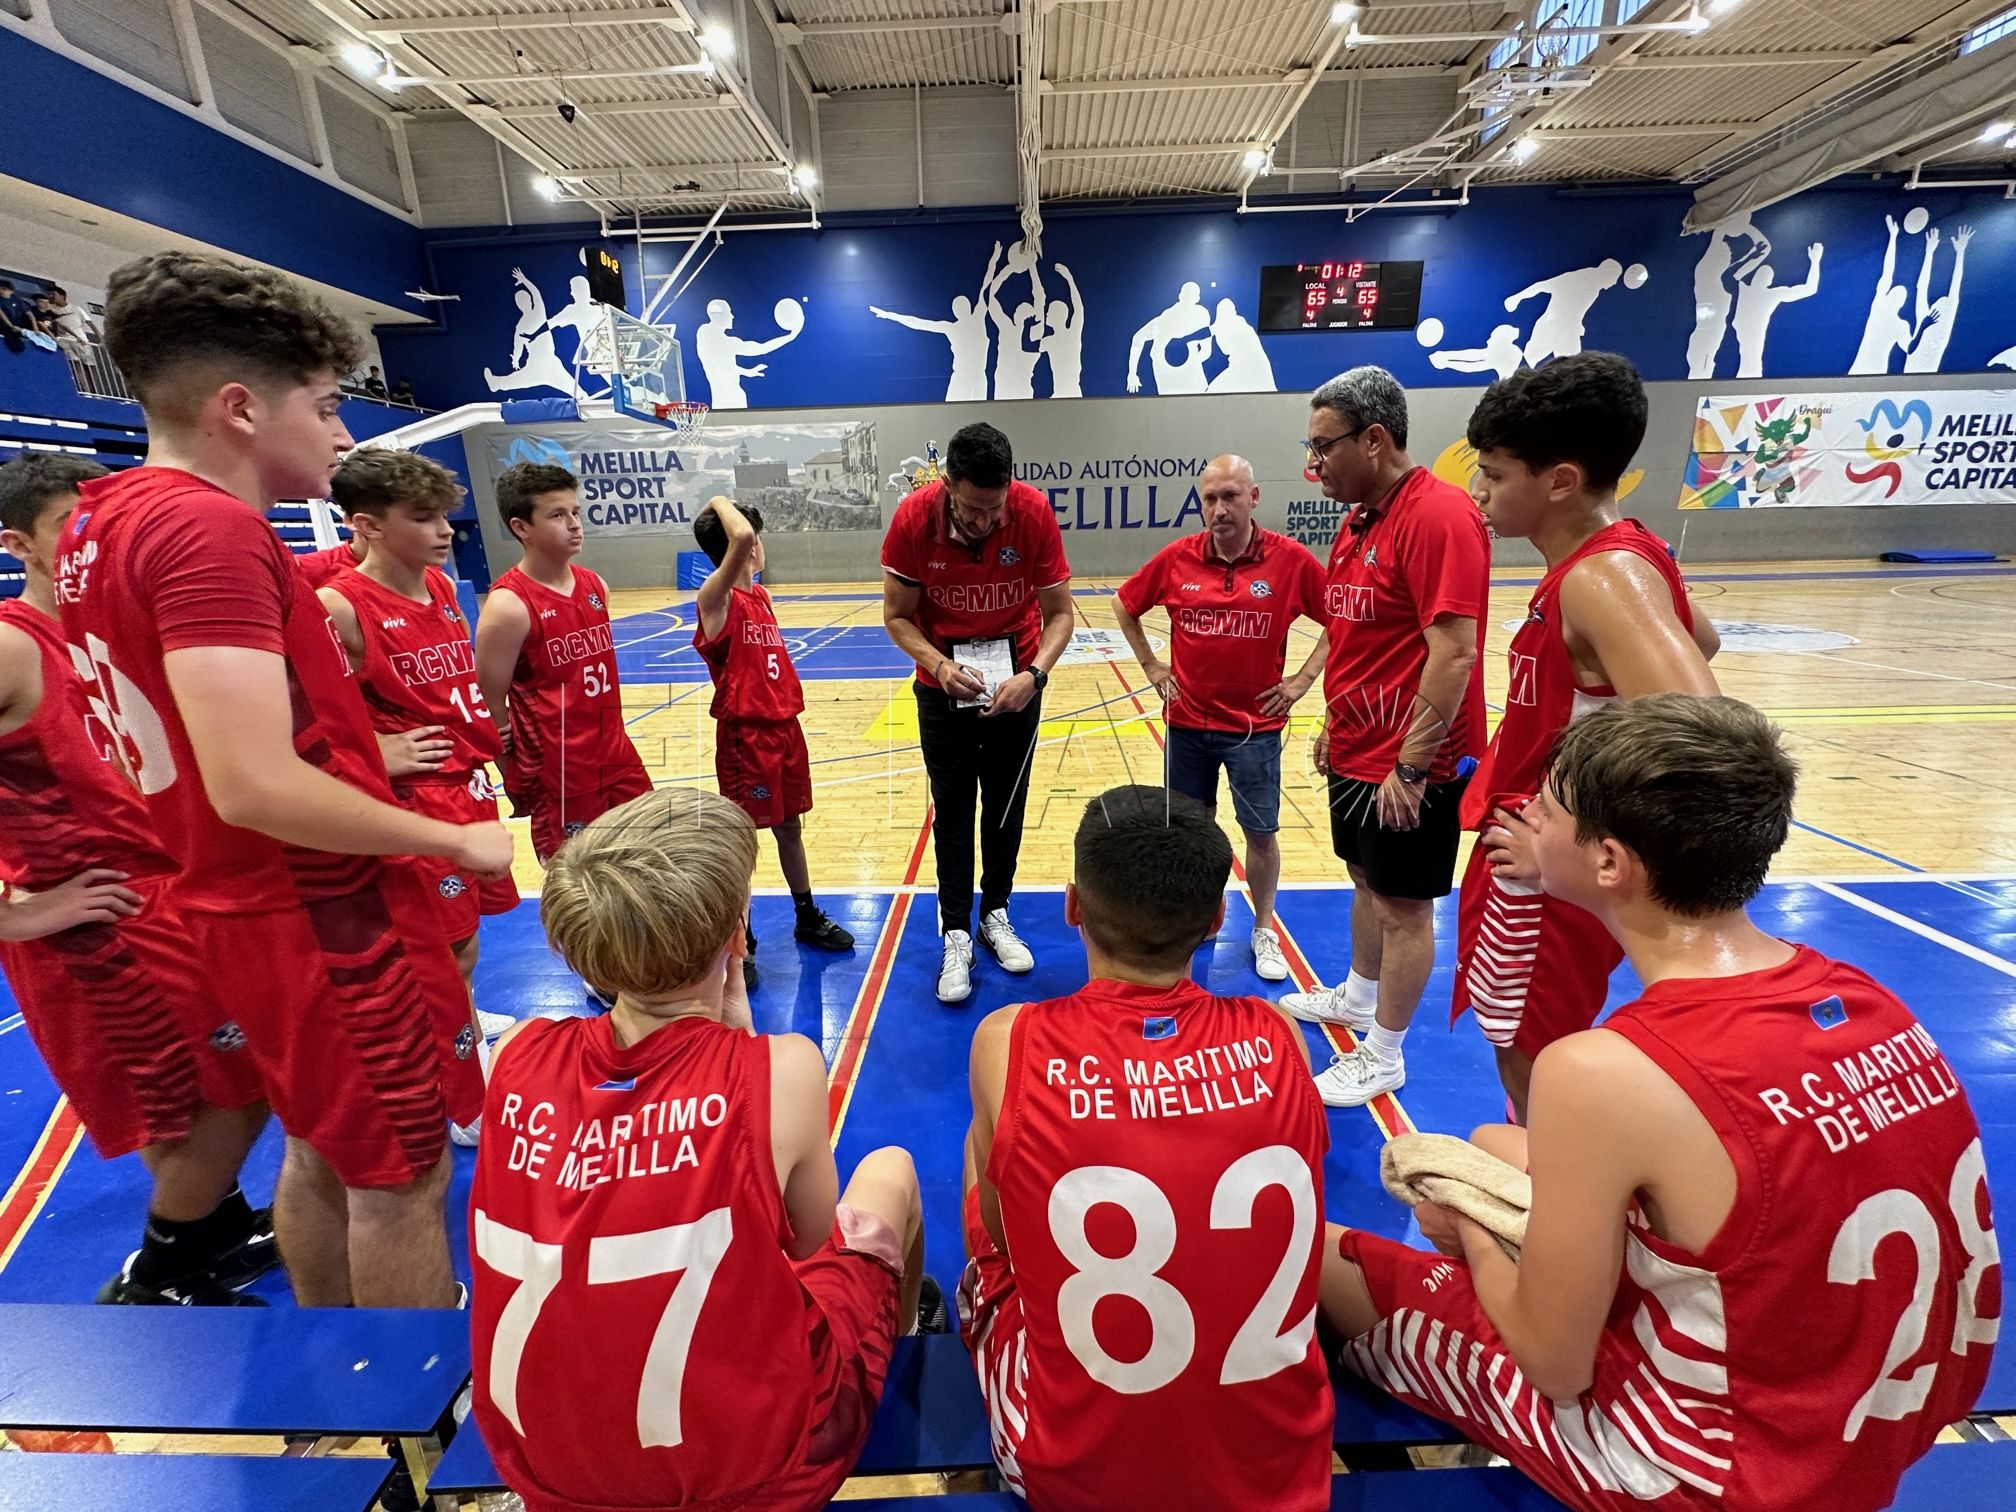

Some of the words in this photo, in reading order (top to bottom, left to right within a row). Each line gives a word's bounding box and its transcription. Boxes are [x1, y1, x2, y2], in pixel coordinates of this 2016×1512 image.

[1322, 263, 1362, 279] 01:12
[1307, 291, 1327, 306] 65
[1336, 287, 1345, 297] 4
[1358, 289, 1378, 305] 65
[1306, 310, 1315, 320] 4
[1363, 308, 1373, 319] 4
[1938, 413, 2016, 437] MELIL
[580, 450, 684, 475] MELILLA
[1012, 461, 1073, 481] UDAD
[583, 476, 666, 501] SPORT
[1925, 467, 2016, 490] CAPITA
[587, 502, 691, 526] CAPITAL
[1041, 484, 1207, 530] ELILLA
[1287, 500, 1351, 515] MELILLA
[1287, 515, 1340, 531] SPORT
[1287, 531, 1340, 546] APIT
[927, 577, 1025, 613] RCMM
[1181, 582, 1202, 592] vive
[382, 616, 408, 630] vive
[1179, 608, 1273, 639] RCMM
[767, 653, 780, 680] 5
[583, 662, 612, 698] 52
[449, 682, 492, 724] 15
[1047, 1055, 1111, 1086] R.C.
[1123, 1036, 1274, 1086] MARITIMO
[1758, 1072, 1845, 1126] R.C.
[1831, 1022, 1938, 1095] MARITIM
[1069, 1088, 1117, 1120] DE
[1129, 1071, 1274, 1120] MELILLA
[500, 1093, 557, 1141] R.C.
[1814, 1104, 1869, 1154] DE
[507, 1135, 553, 1180] DE
[1048, 1144, 1317, 1395] 82
[1827, 1136, 2001, 1442] 28
[475, 1206, 734, 1449] 77
